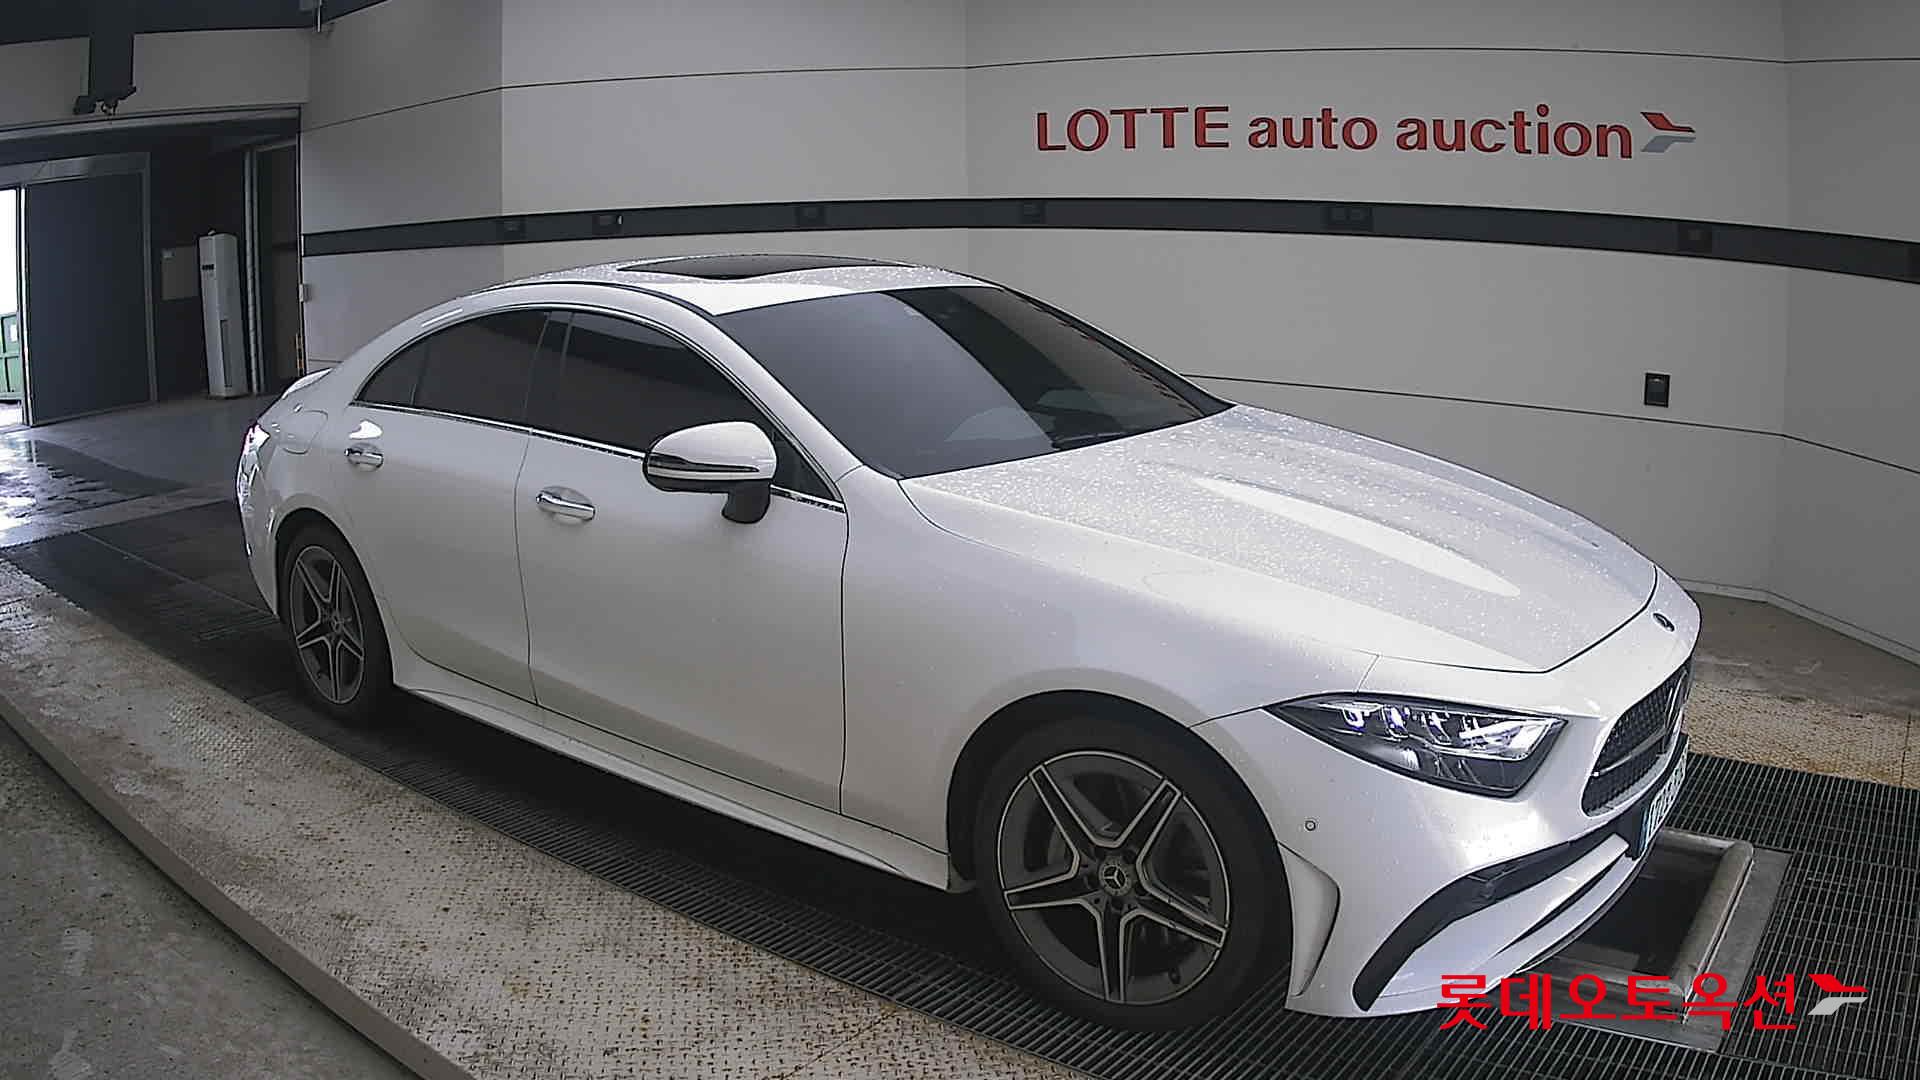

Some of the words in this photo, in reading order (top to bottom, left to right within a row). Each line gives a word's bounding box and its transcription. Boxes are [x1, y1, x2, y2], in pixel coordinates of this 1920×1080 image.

[1036, 106, 1230, 151] LOTTE
[1247, 107, 1379, 149] auto
[1395, 103, 1633, 159] auction
